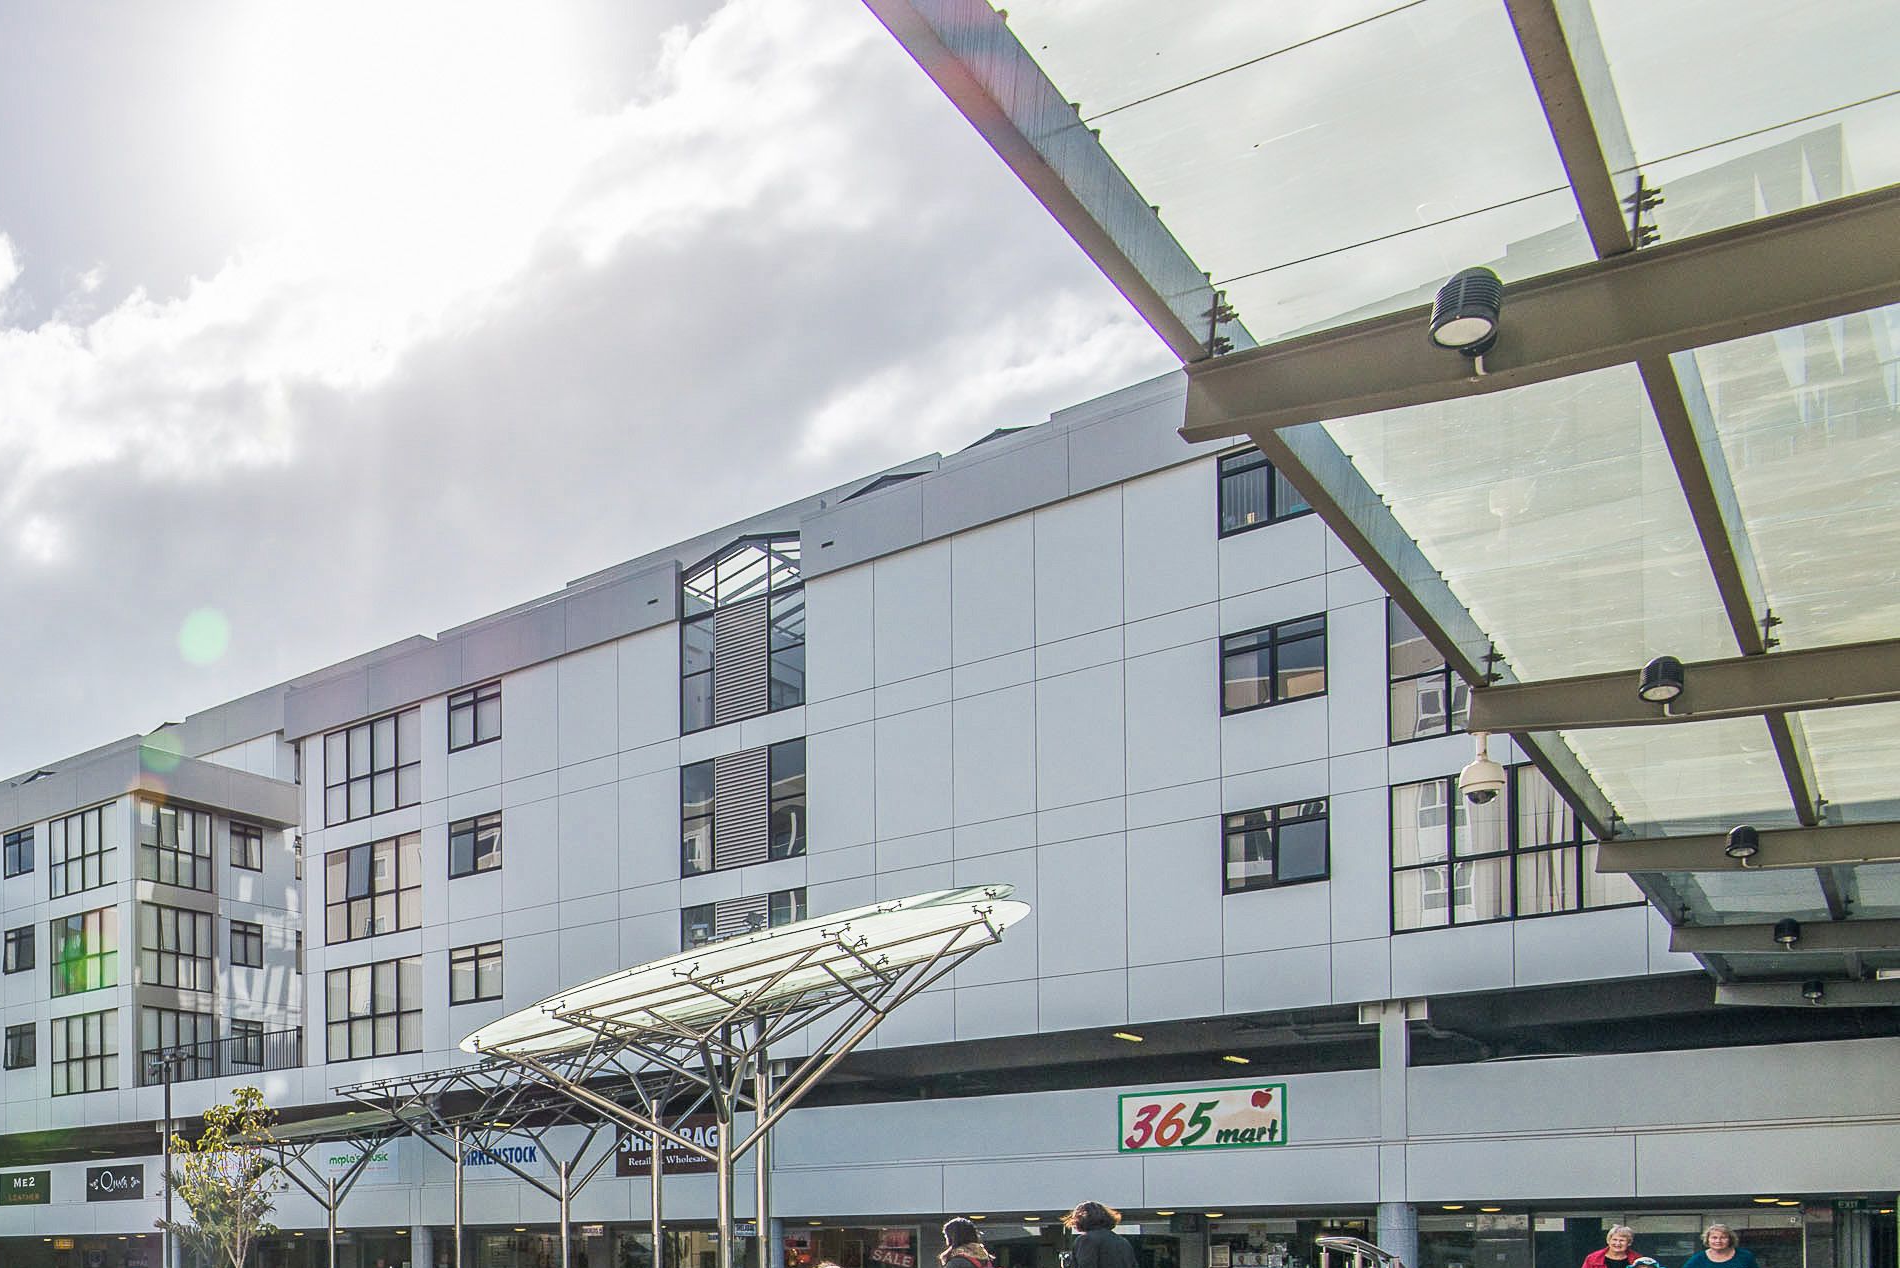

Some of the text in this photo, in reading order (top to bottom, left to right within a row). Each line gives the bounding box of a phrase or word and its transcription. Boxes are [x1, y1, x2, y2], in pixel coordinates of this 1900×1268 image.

[1125, 1100, 1278, 1149] 365 mart
[368, 1153, 388, 1162] usic
[628, 1154, 707, 1166] Retail Wholesale
[872, 1249, 914, 1267] SALE
